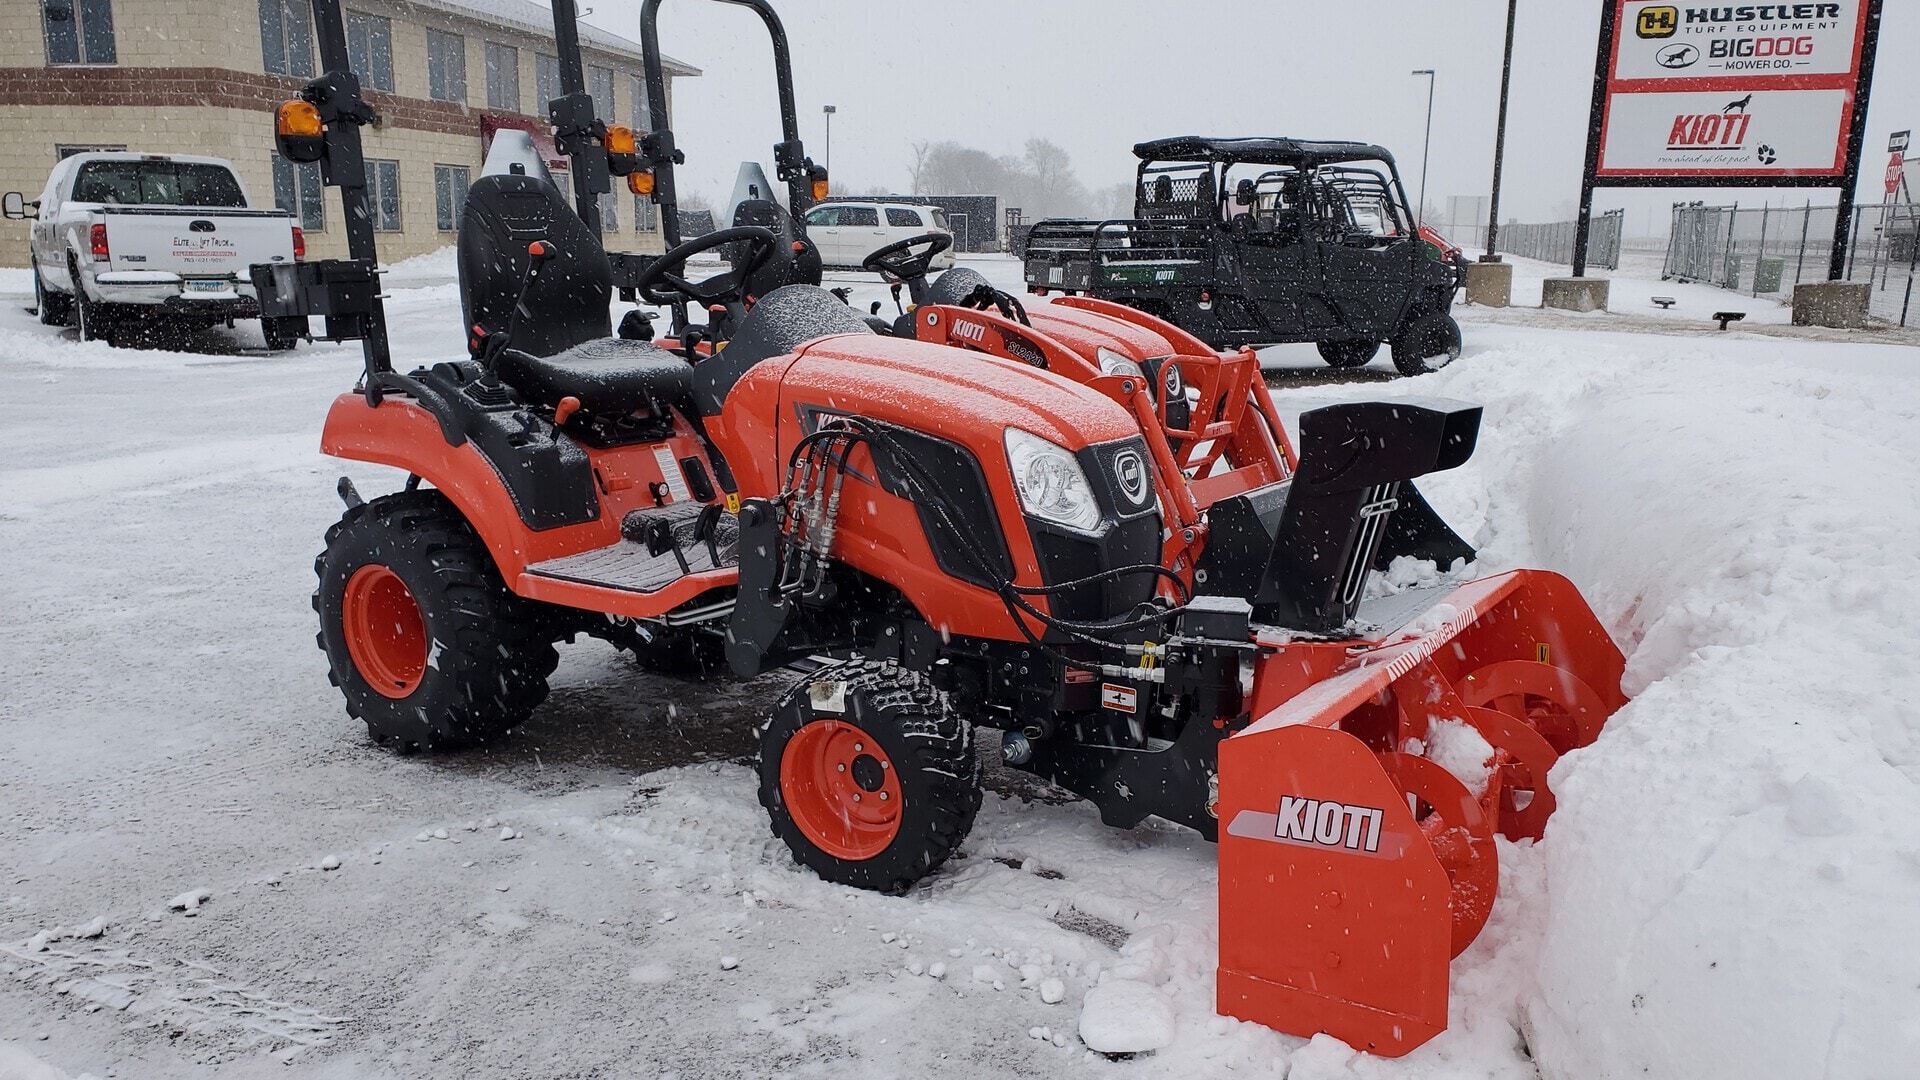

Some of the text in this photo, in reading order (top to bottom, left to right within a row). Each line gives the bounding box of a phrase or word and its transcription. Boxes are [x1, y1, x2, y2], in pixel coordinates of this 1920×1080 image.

[1685, 4, 1840, 24] HUSTLER
[1685, 21, 1839, 35] TURF EQUIPMENT
[1709, 36, 1814, 58] BIGDOG
[1725, 59, 1793, 71] MOWER CO.
[1667, 114, 1751, 146] KIOTI
[1886, 165, 1902, 182] STOP
[1155, 270, 1175, 281] KIOTI
[952, 318, 986, 342] KIOTI
[1422, 622, 1456, 658] DANGER
[1275, 795, 1384, 853] KIOTI
